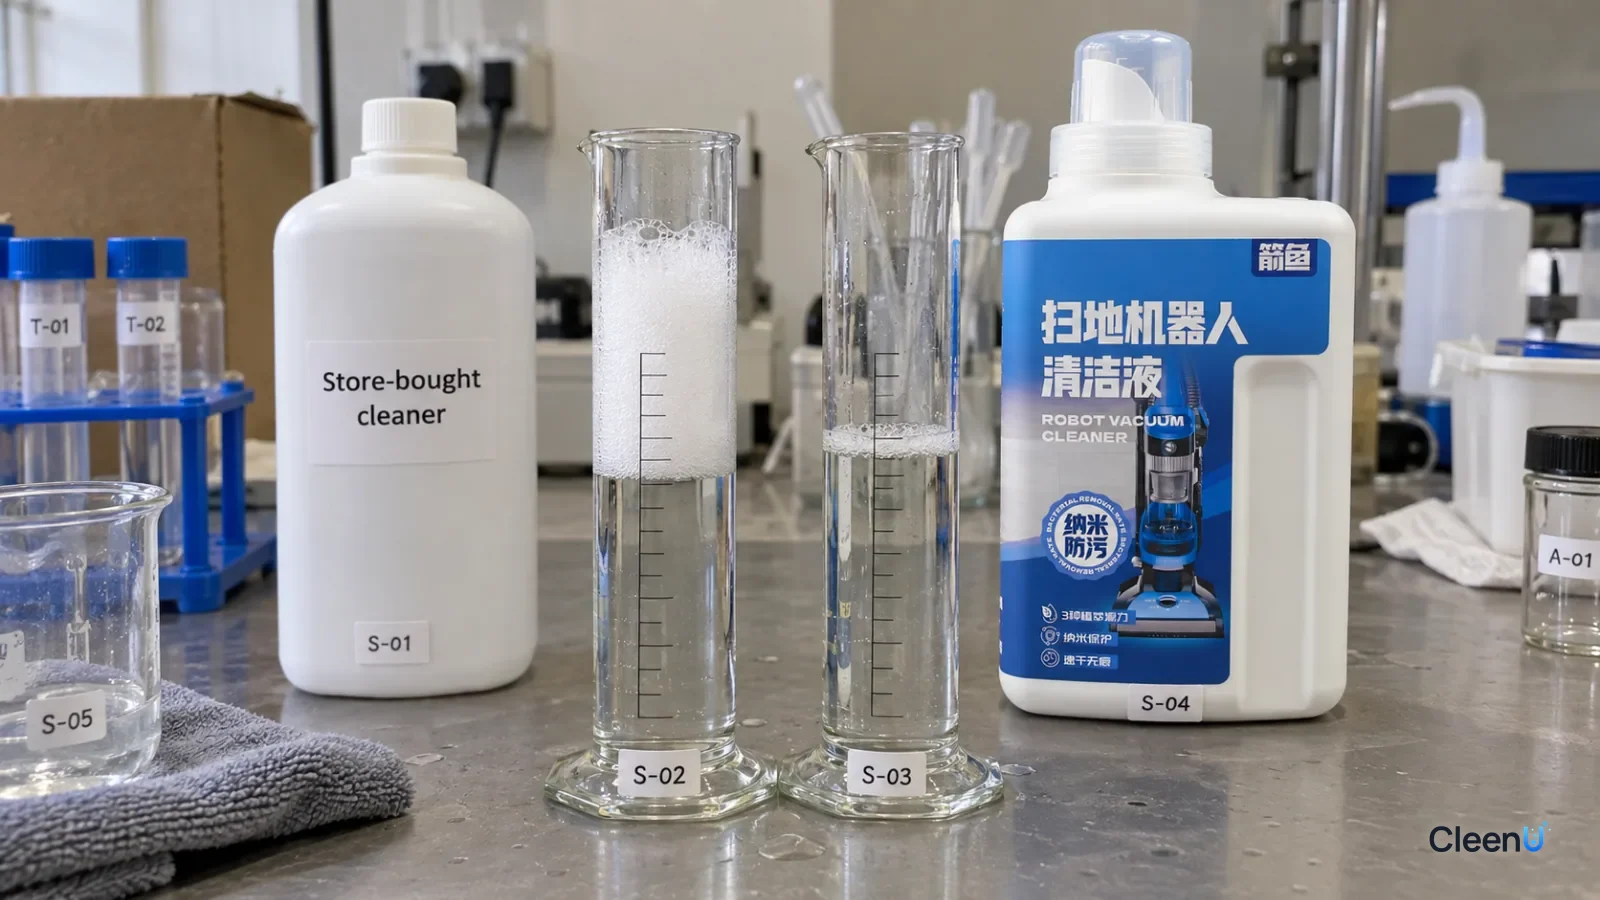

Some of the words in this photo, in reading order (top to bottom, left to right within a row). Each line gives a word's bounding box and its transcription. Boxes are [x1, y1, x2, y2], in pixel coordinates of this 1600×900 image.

[1258, 243, 1311, 272] 箭鱼
[30, 318, 69, 335] T-01
[126, 316, 166, 333] T-02
[1041, 300, 1249, 345] 扫地机器人
[323, 368, 481, 394] Store-bought
[1041, 355, 1163, 399] 清洁液
[357, 404, 446, 426] cleaner
[1041, 414, 1106, 427] ROBOT
[1109, 415, 1185, 427] VACUUM
[1042, 431, 1128, 444] CLEANER
[1079, 496, 1115, 513] REMOVAL
[1062, 513, 1108, 536] 纳米
[1064, 537, 1108, 561] 防污
[1549, 548, 1592, 568] A-01
[368, 635, 410, 652] S-01
[1063, 632, 1112, 645] 纳米保护
[1063, 655, 1111, 667] 速干无痕
[1141, 695, 1191, 711] S-04
[42, 708, 93, 734] S-05
[633, 765, 686, 785] S-02
[861, 765, 912, 785] S-03
